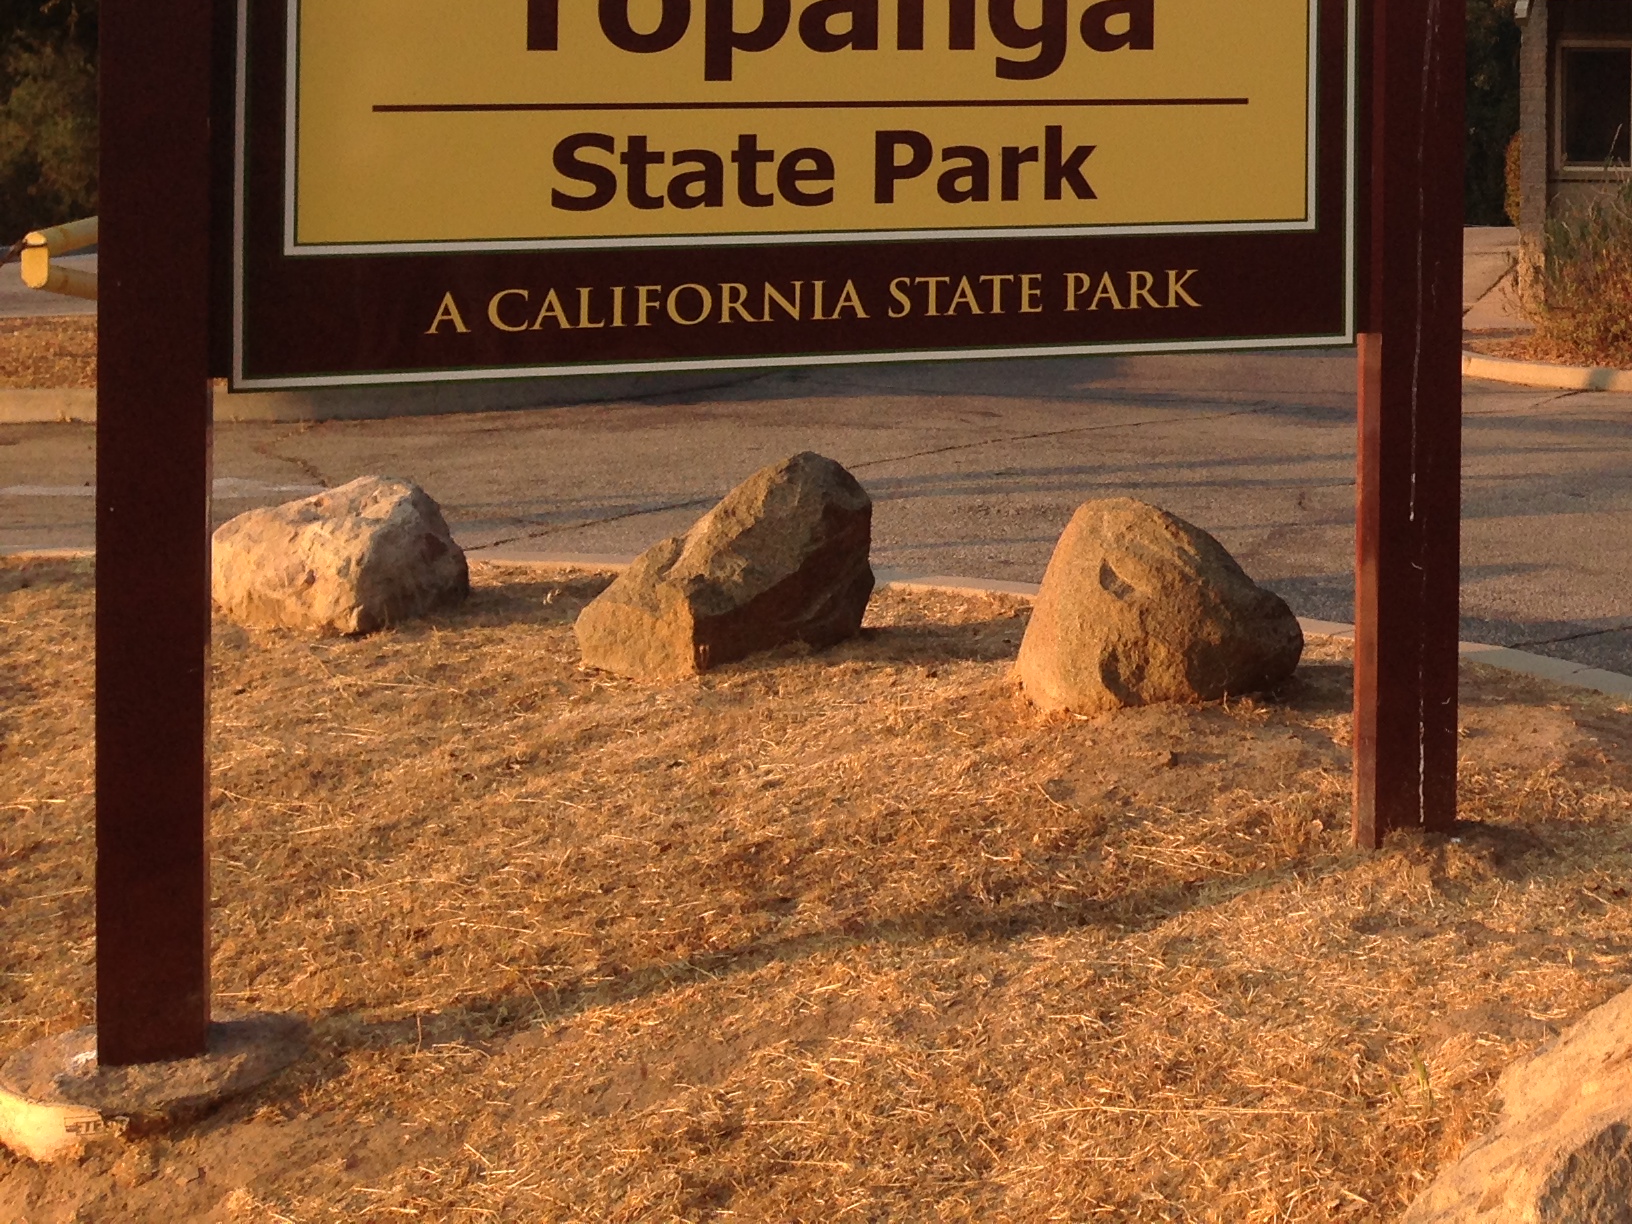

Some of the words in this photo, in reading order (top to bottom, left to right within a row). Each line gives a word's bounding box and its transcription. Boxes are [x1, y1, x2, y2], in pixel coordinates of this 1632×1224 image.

[549, 131, 836, 212] State
[873, 124, 1098, 205] Park
[424, 291, 471, 335] A
[487, 278, 870, 332] CALIFORNIA
[887, 273, 1044, 319] STATE
[1062, 268, 1202, 313] PARK
